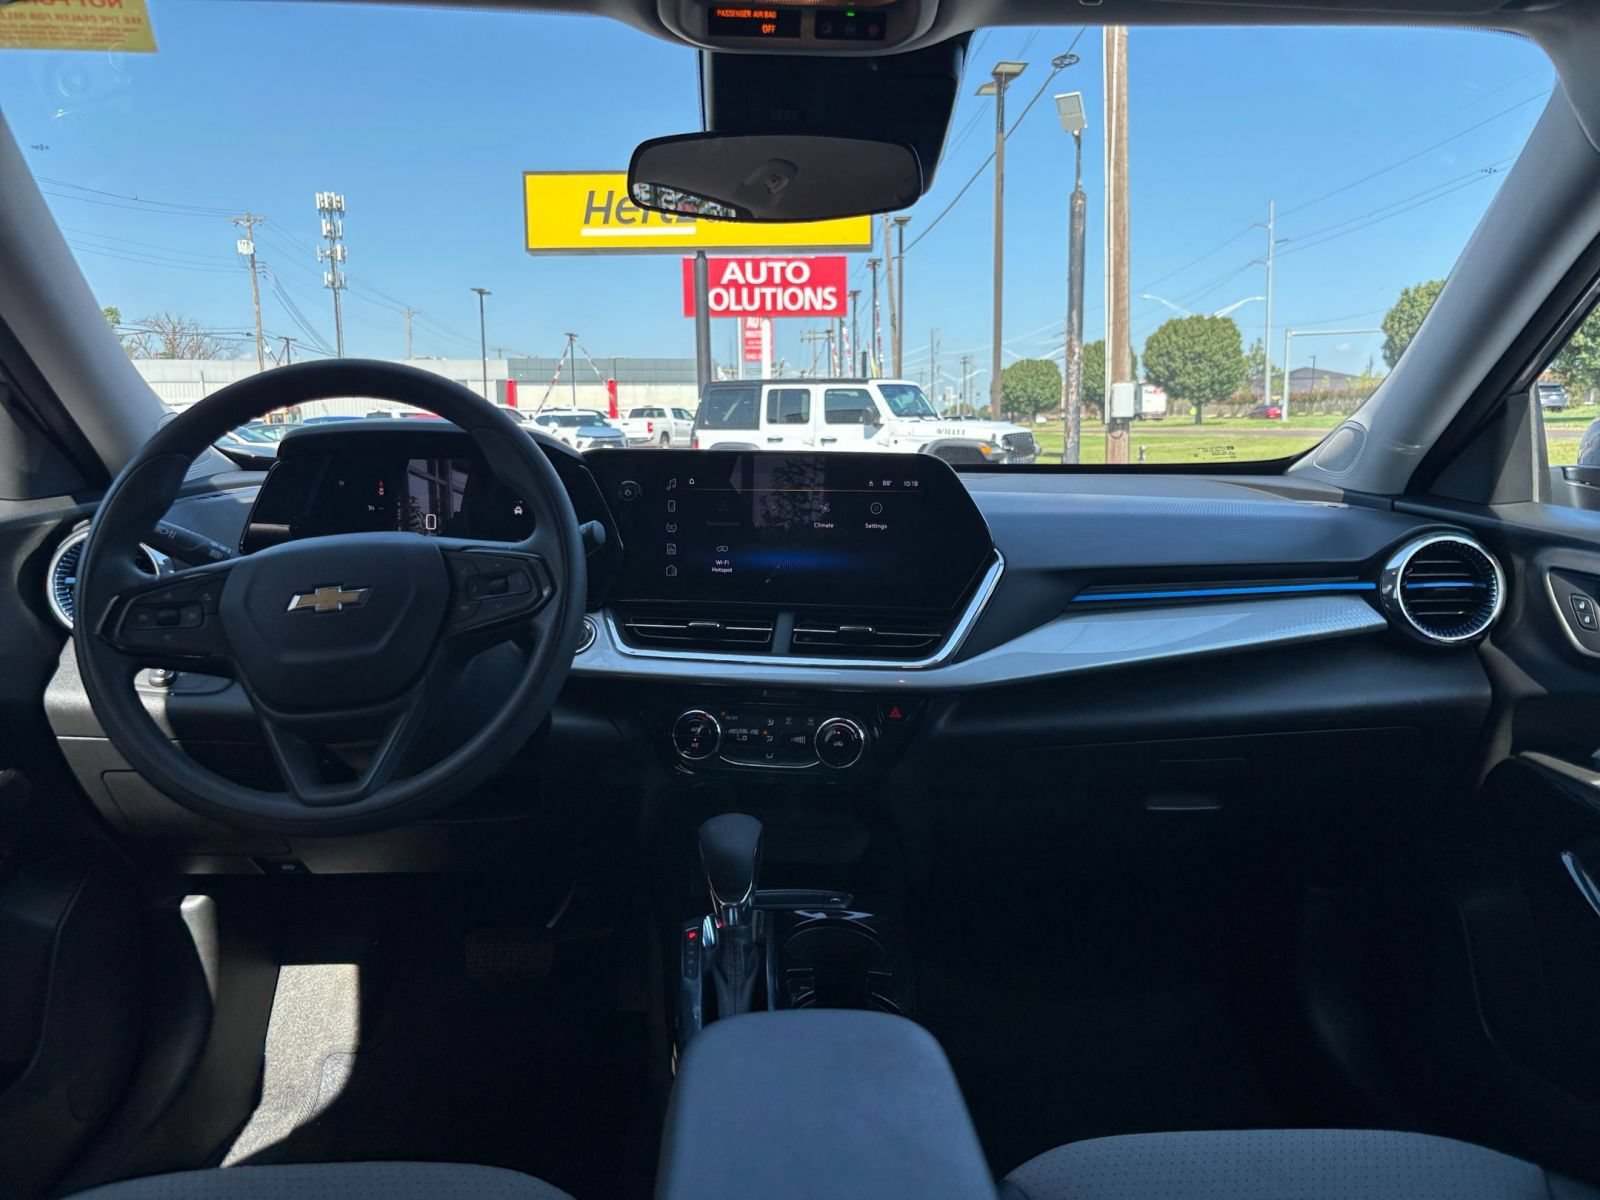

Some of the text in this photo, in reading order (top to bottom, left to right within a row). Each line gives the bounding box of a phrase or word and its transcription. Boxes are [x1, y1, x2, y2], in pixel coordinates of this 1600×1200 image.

[717, 9, 751, 18] PASSENGER
[762, 24, 776, 33] OFF
[720, 261, 811, 285] AUTO
[706, 287, 838, 312] OLUTIONS
[865, 522, 888, 531] Settings
